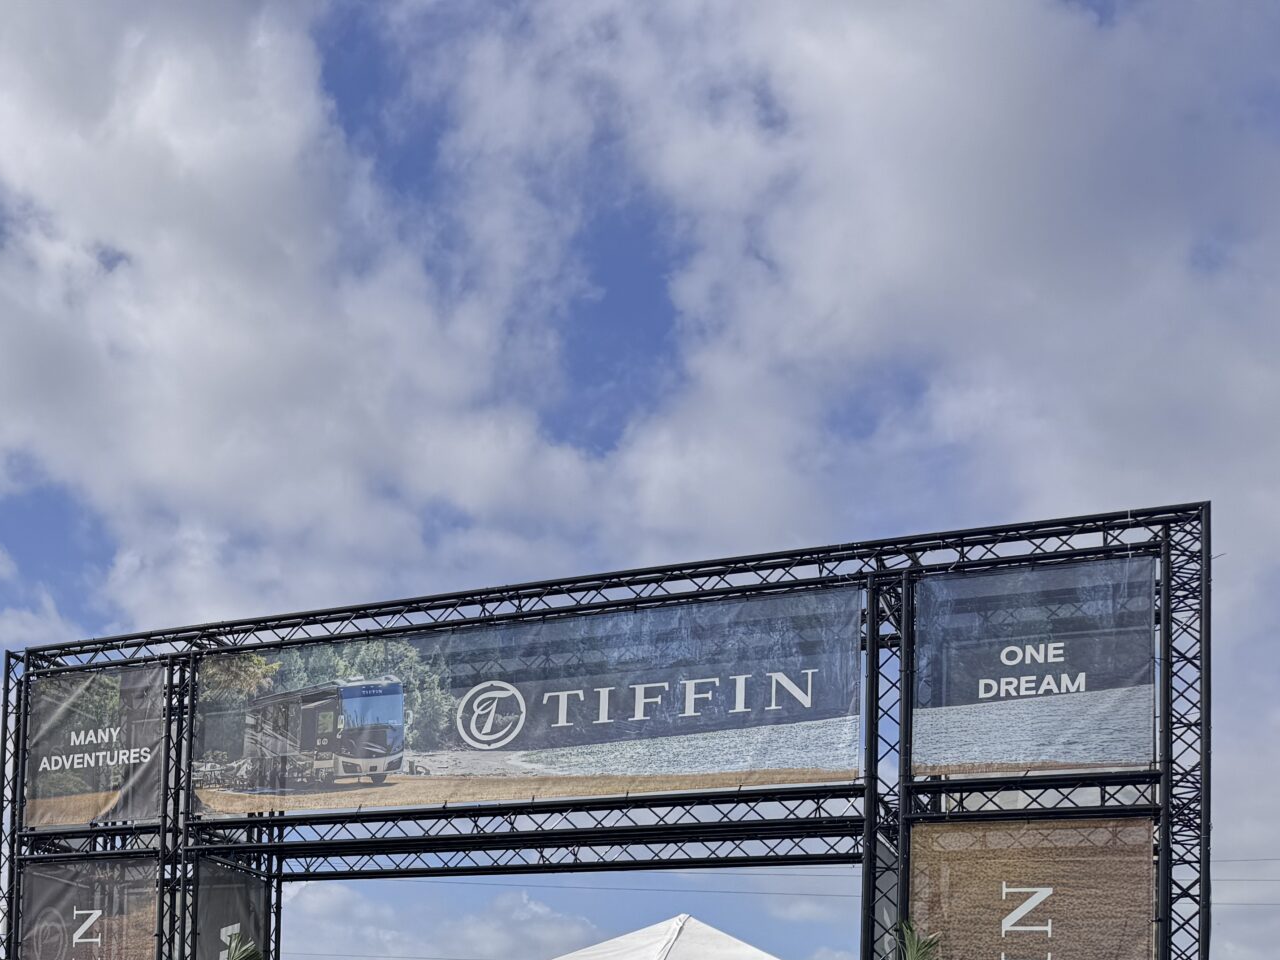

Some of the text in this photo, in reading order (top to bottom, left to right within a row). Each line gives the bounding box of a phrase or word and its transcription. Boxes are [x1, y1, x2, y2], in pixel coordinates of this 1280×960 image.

[999, 641, 1066, 665] ONE
[977, 671, 1087, 700] DREAM
[542, 668, 819, 729] TIFFIN
[69, 726, 122, 747] MANY
[37, 747, 152, 772] ADVENTURES
